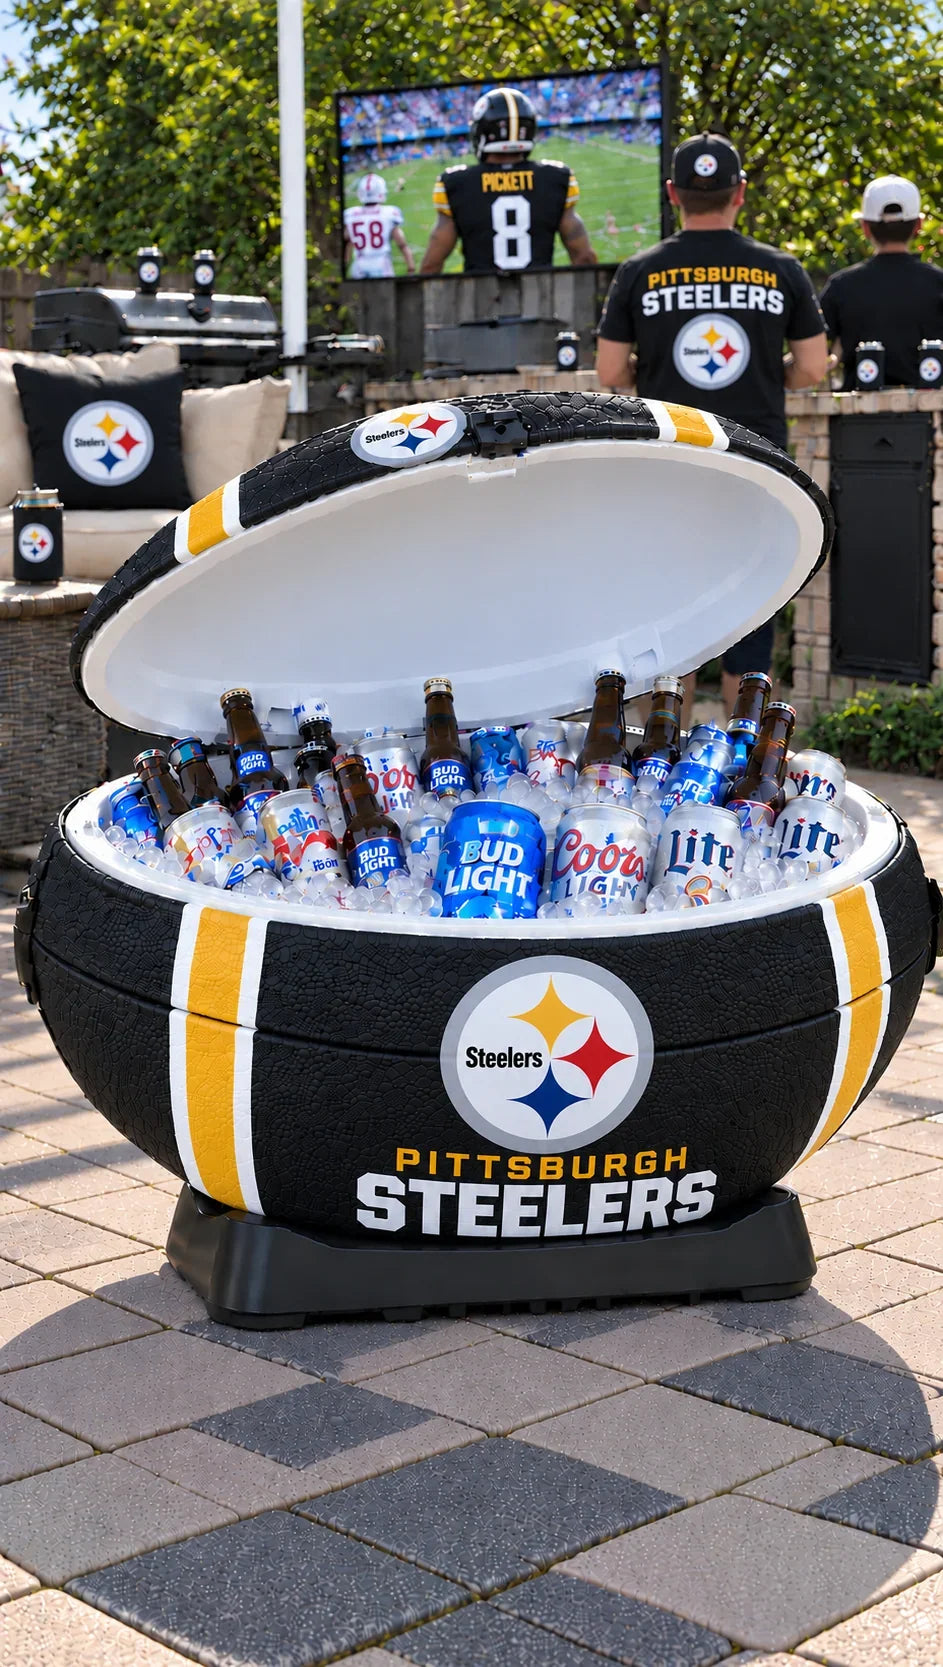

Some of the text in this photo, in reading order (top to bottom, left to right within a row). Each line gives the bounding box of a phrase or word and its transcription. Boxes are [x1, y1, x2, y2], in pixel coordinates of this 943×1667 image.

[482, 170, 534, 193] PICKETT
[352, 221, 384, 250] 58
[491, 195, 532, 270] 8
[648, 266, 778, 289] PITTSBURGH
[641, 283, 785, 317] STEELERS
[74, 436, 106, 448] Steelers
[365, 427, 406, 444] Steelers
[430, 775, 466, 790] LIGHT
[433, 765, 460, 779] BUD
[777, 817, 841, 859] Lite
[359, 846, 389, 864] BUD
[459, 840, 525, 867] BUD
[551, 828, 644, 882] Coors
[664, 828, 735, 878] Lite
[358, 856, 397, 878] LIGHT
[444, 865, 534, 899] LIGHT
[465, 1046, 543, 1069] Steelers
[395, 1146, 688, 1180] PITTSBURGH
[356, 1169, 718, 1238] STEELERS
